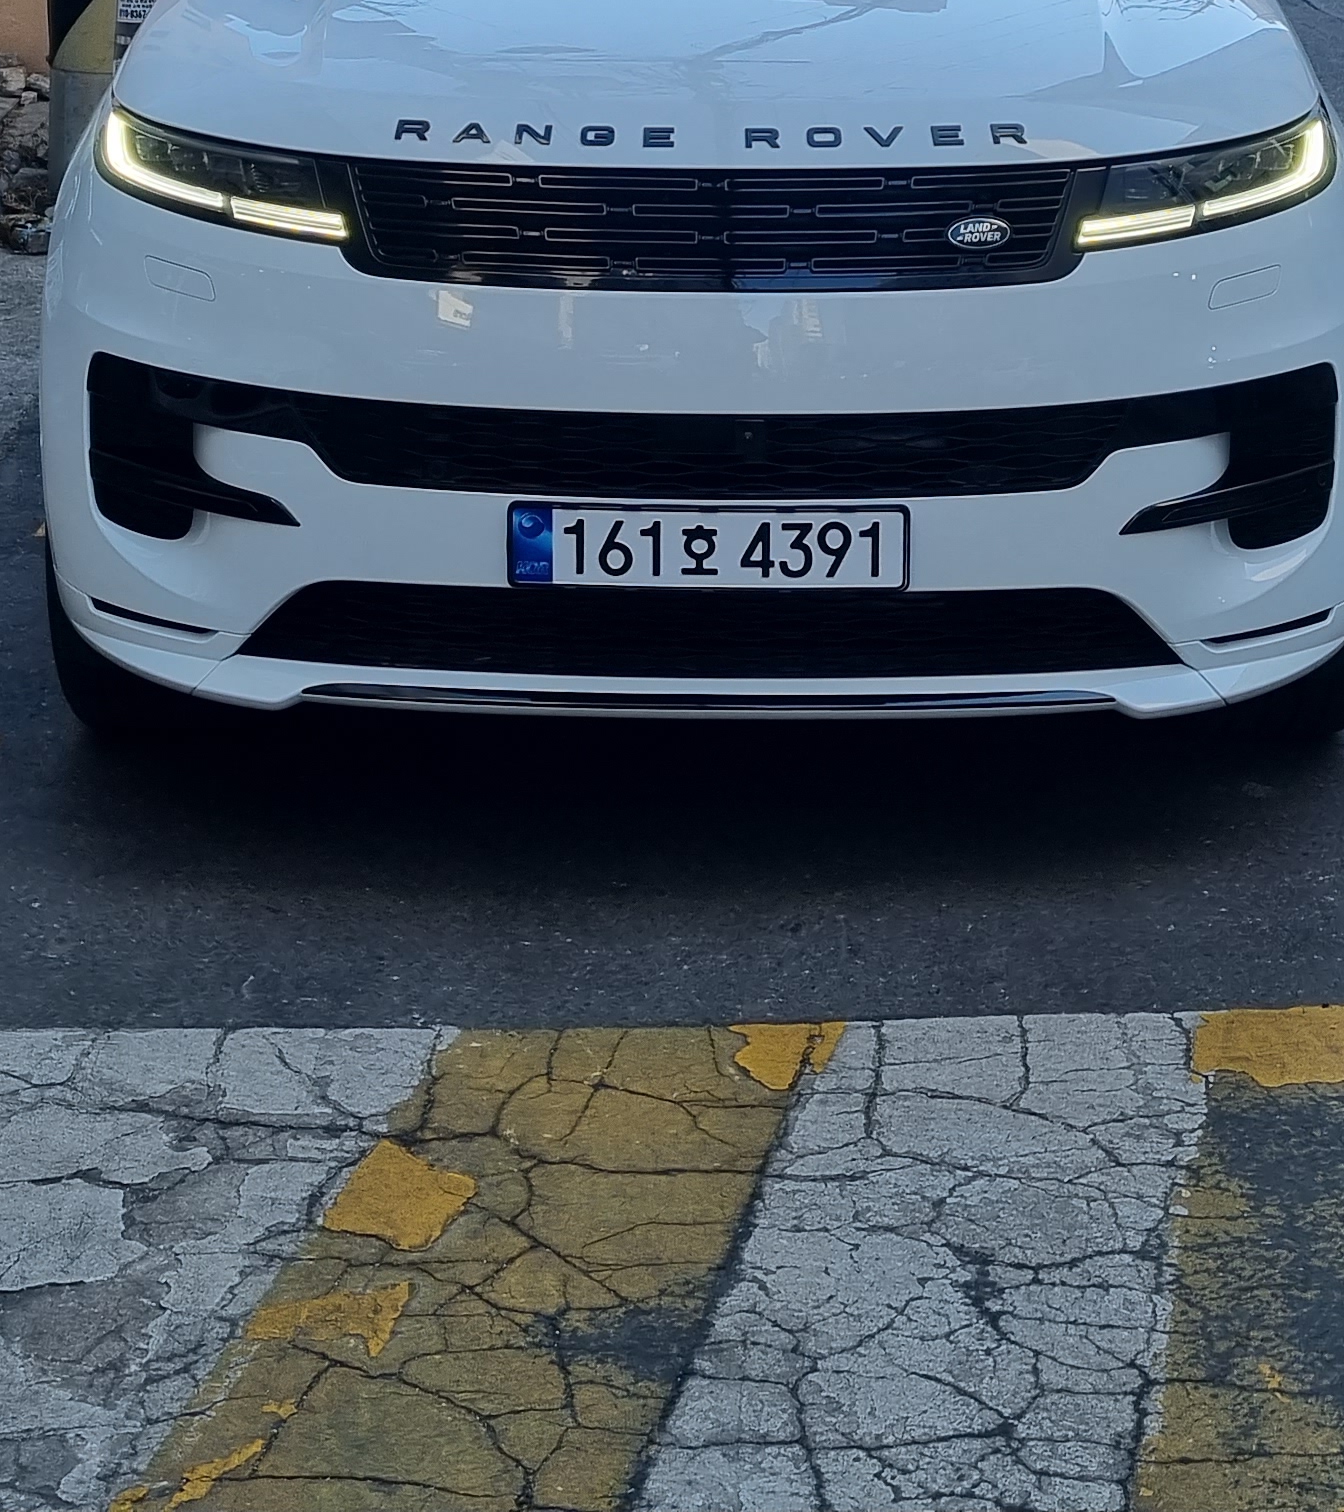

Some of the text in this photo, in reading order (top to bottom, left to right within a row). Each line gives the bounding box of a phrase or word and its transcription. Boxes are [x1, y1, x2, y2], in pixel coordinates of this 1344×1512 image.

[394, 119, 1029, 150] RANGE ROVER
[960, 222, 991, 234] LAND
[963, 231, 1002, 243] ROVER
[563, 518, 881, 578] 161호 4391
